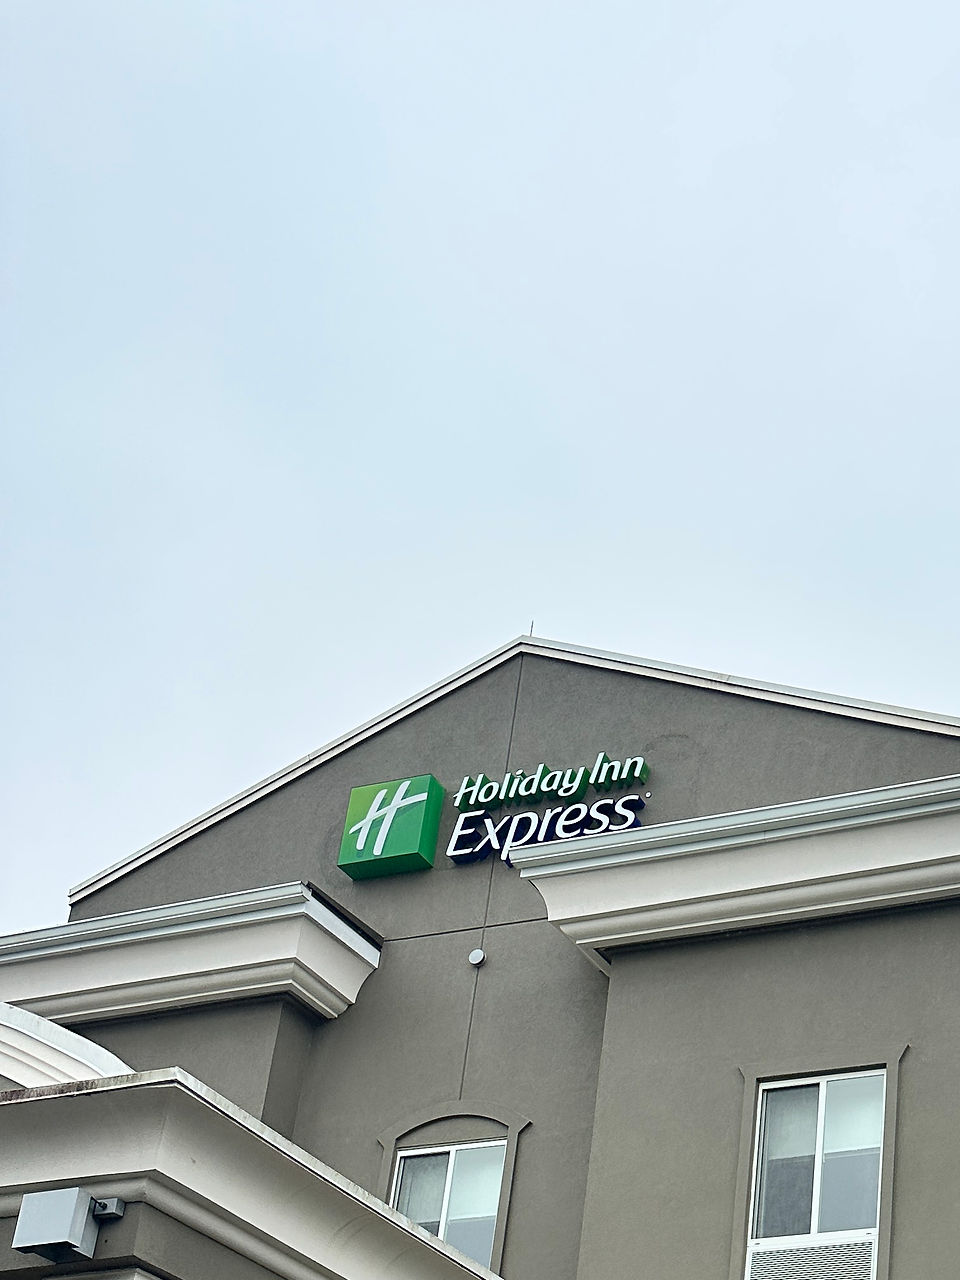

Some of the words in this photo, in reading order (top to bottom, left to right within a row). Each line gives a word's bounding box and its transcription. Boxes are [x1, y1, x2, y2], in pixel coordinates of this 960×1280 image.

[452, 763, 587, 807] Holiday
[588, 751, 645, 784] Inn
[445, 793, 641, 861] Express
